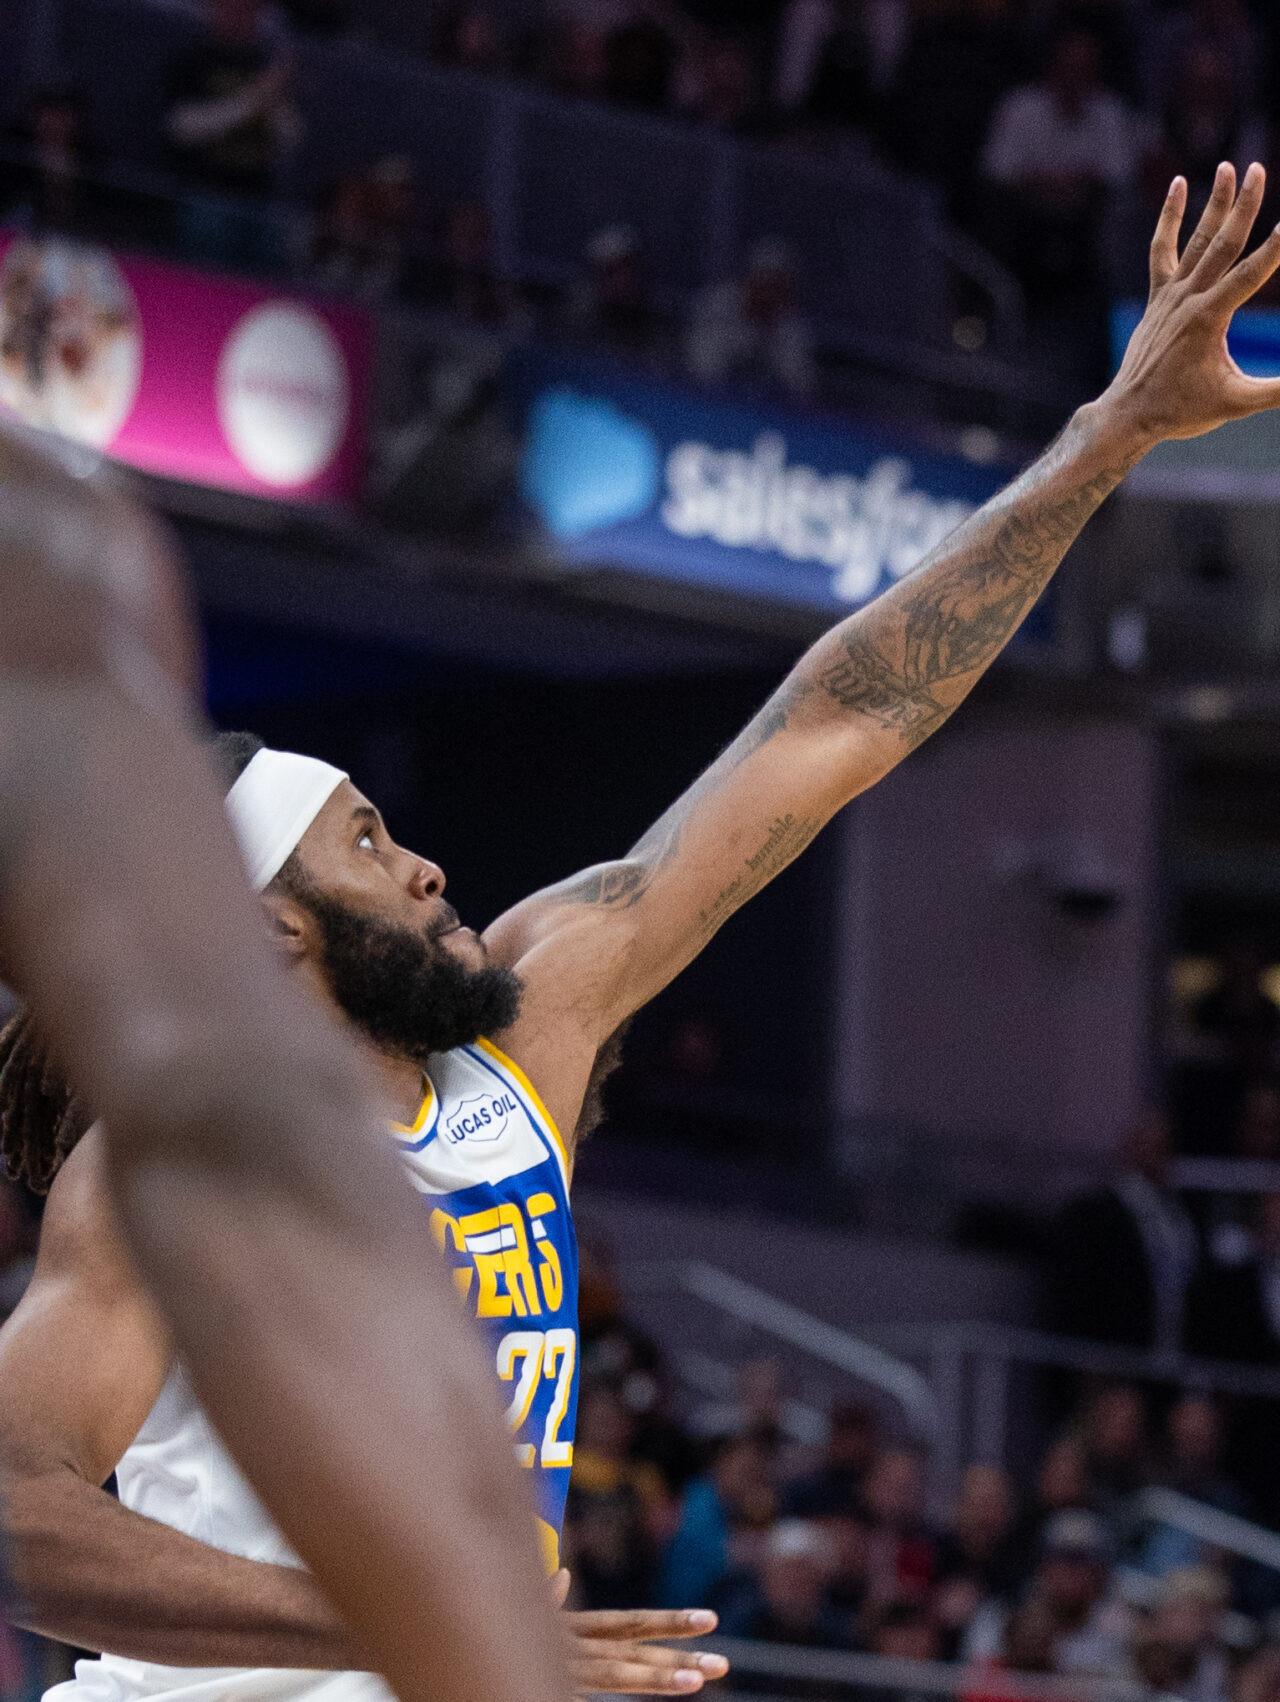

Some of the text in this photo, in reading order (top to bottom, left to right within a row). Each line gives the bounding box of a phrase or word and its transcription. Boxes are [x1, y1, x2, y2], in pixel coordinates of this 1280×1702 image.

[445, 1094, 516, 1144] LUCAS OIL
[497, 1328, 577, 1468] 22
